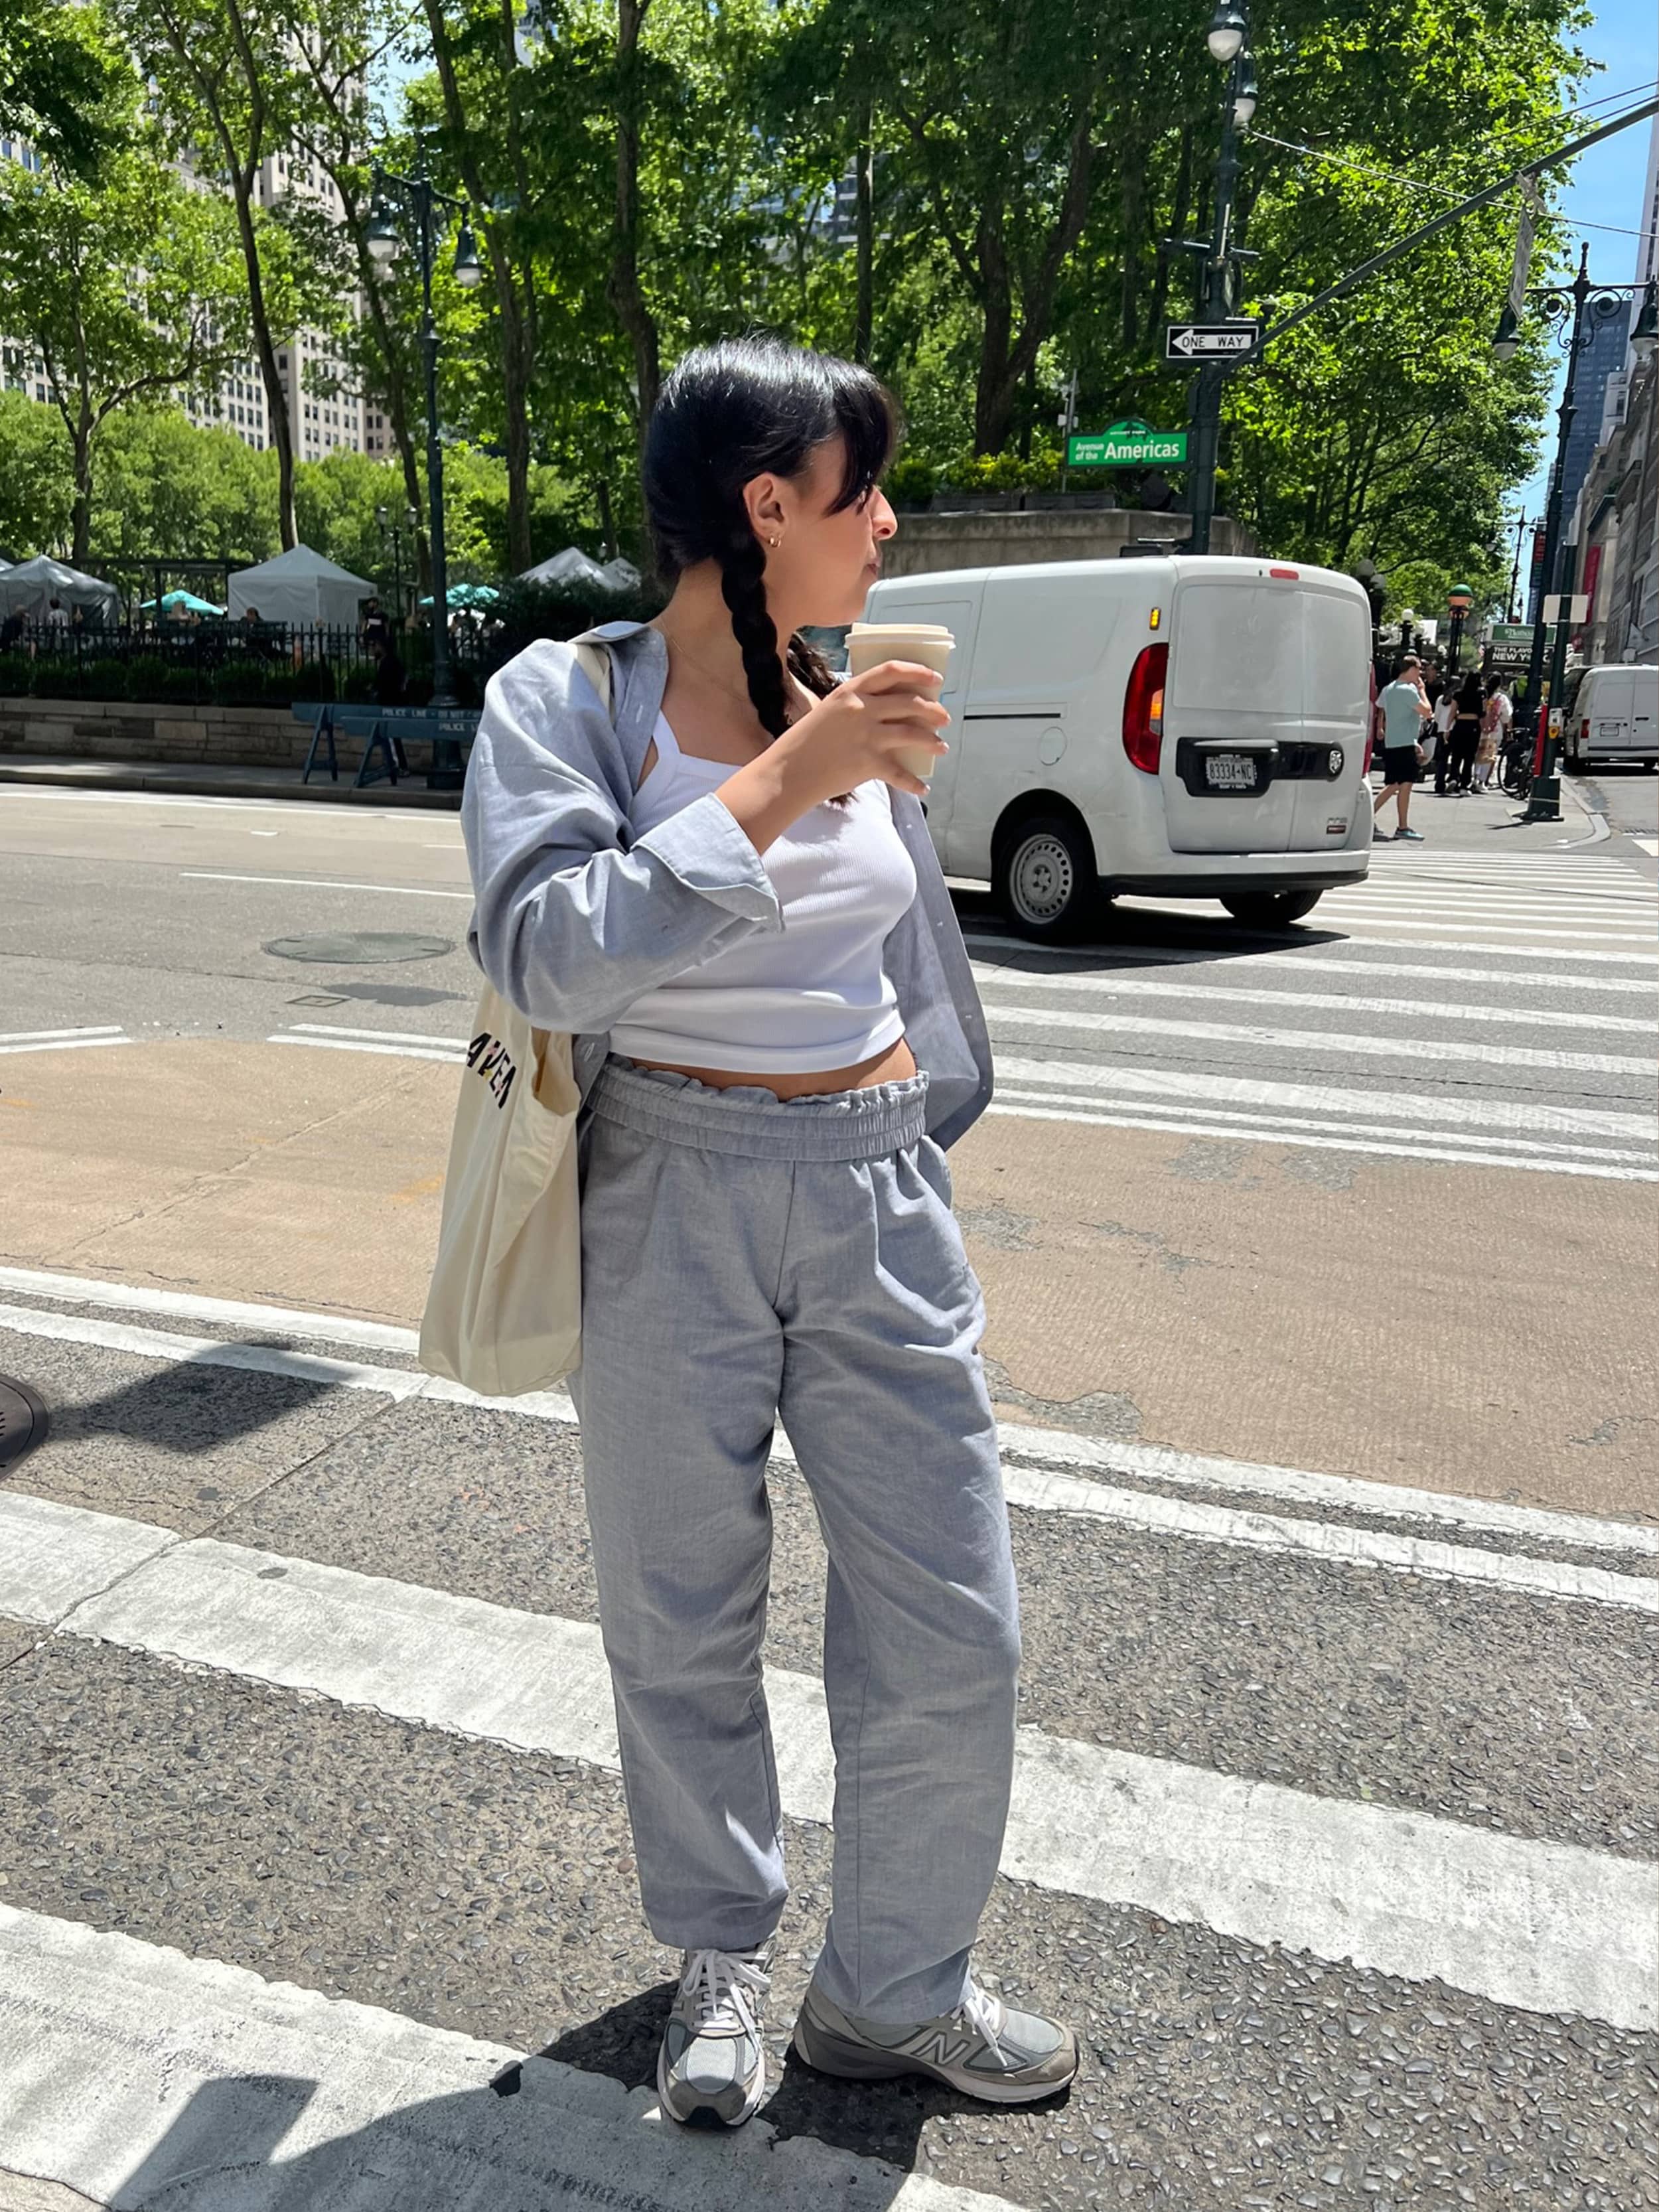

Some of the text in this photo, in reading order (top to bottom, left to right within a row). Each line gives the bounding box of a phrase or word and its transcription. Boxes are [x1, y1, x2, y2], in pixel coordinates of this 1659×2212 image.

[1182, 336, 1244, 348] ONE WAY
[1076, 442, 1104, 451] Avenue
[1104, 440, 1179, 459] Americas
[1075, 452, 1084, 461] of
[382, 707, 406, 716] POLICE
[439, 723, 465, 731] POLICE
